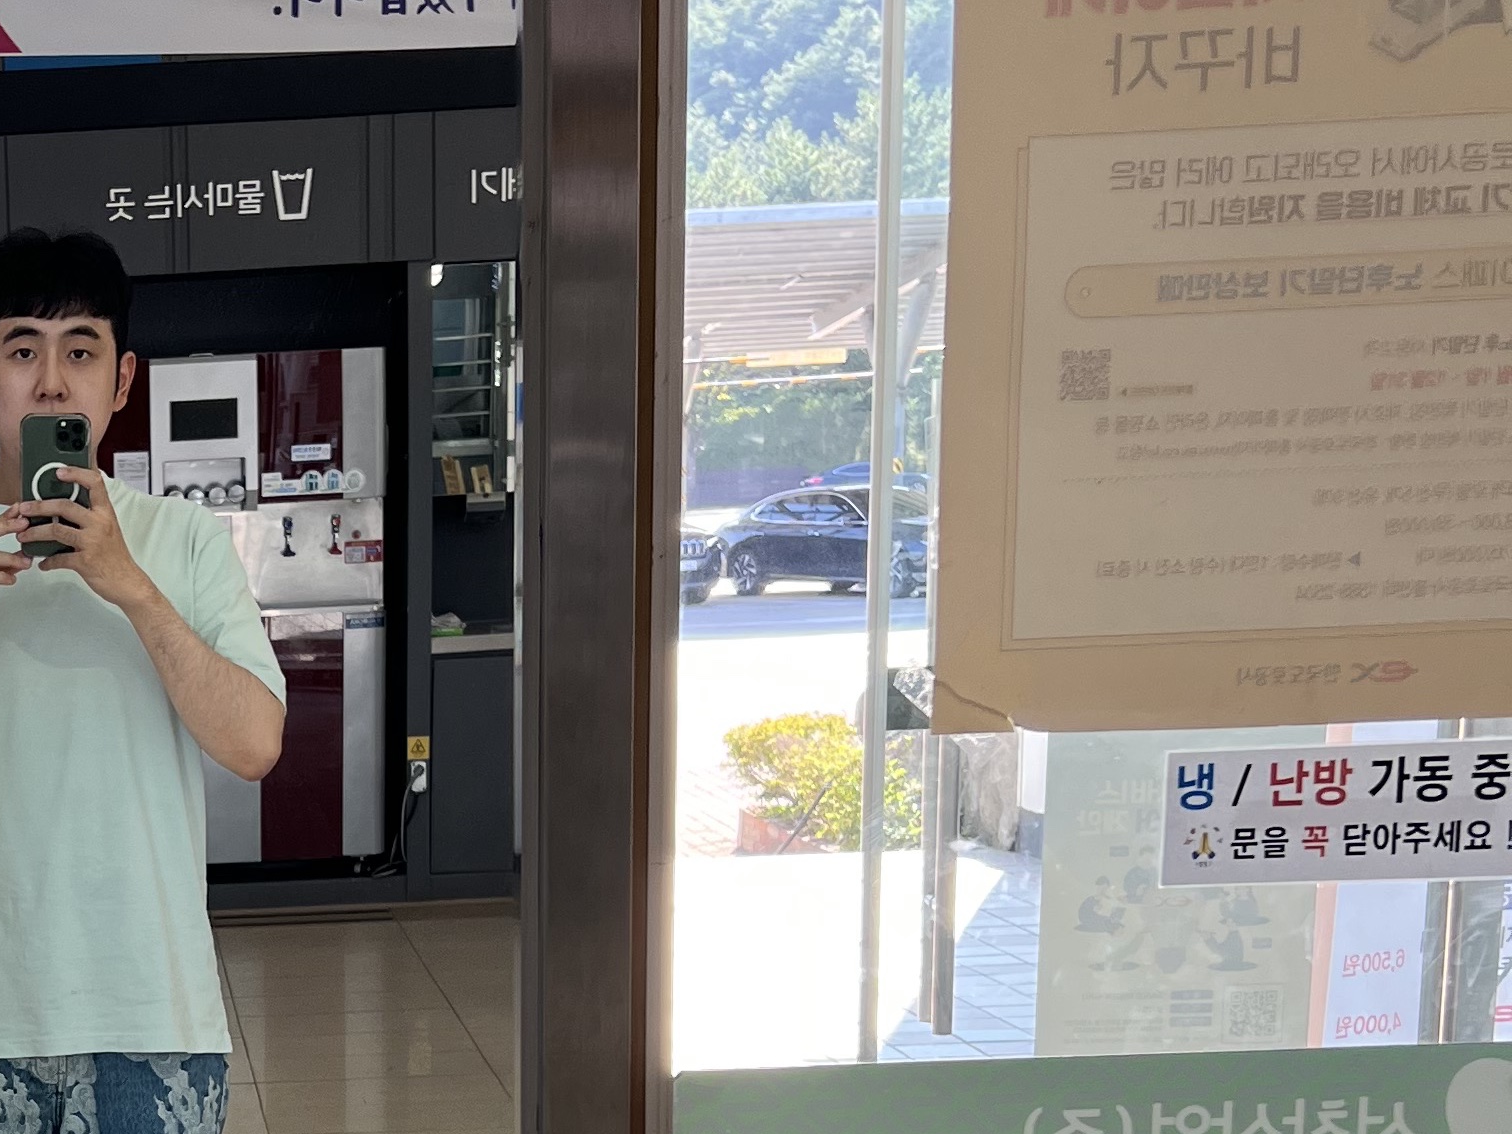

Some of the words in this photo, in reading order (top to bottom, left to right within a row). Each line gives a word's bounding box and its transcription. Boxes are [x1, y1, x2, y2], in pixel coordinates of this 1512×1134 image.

[1177, 762, 1216, 811] 냉
[1231, 763, 1253, 807] /
[1267, 757, 1354, 807] 난방
[1368, 754, 1454, 804] 가동
[1470, 752, 1512, 801] 중
[1229, 826, 1290, 860] 문을
[1301, 825, 1330, 858] 꼭
[1342, 819, 1493, 856] 닫아주세요
